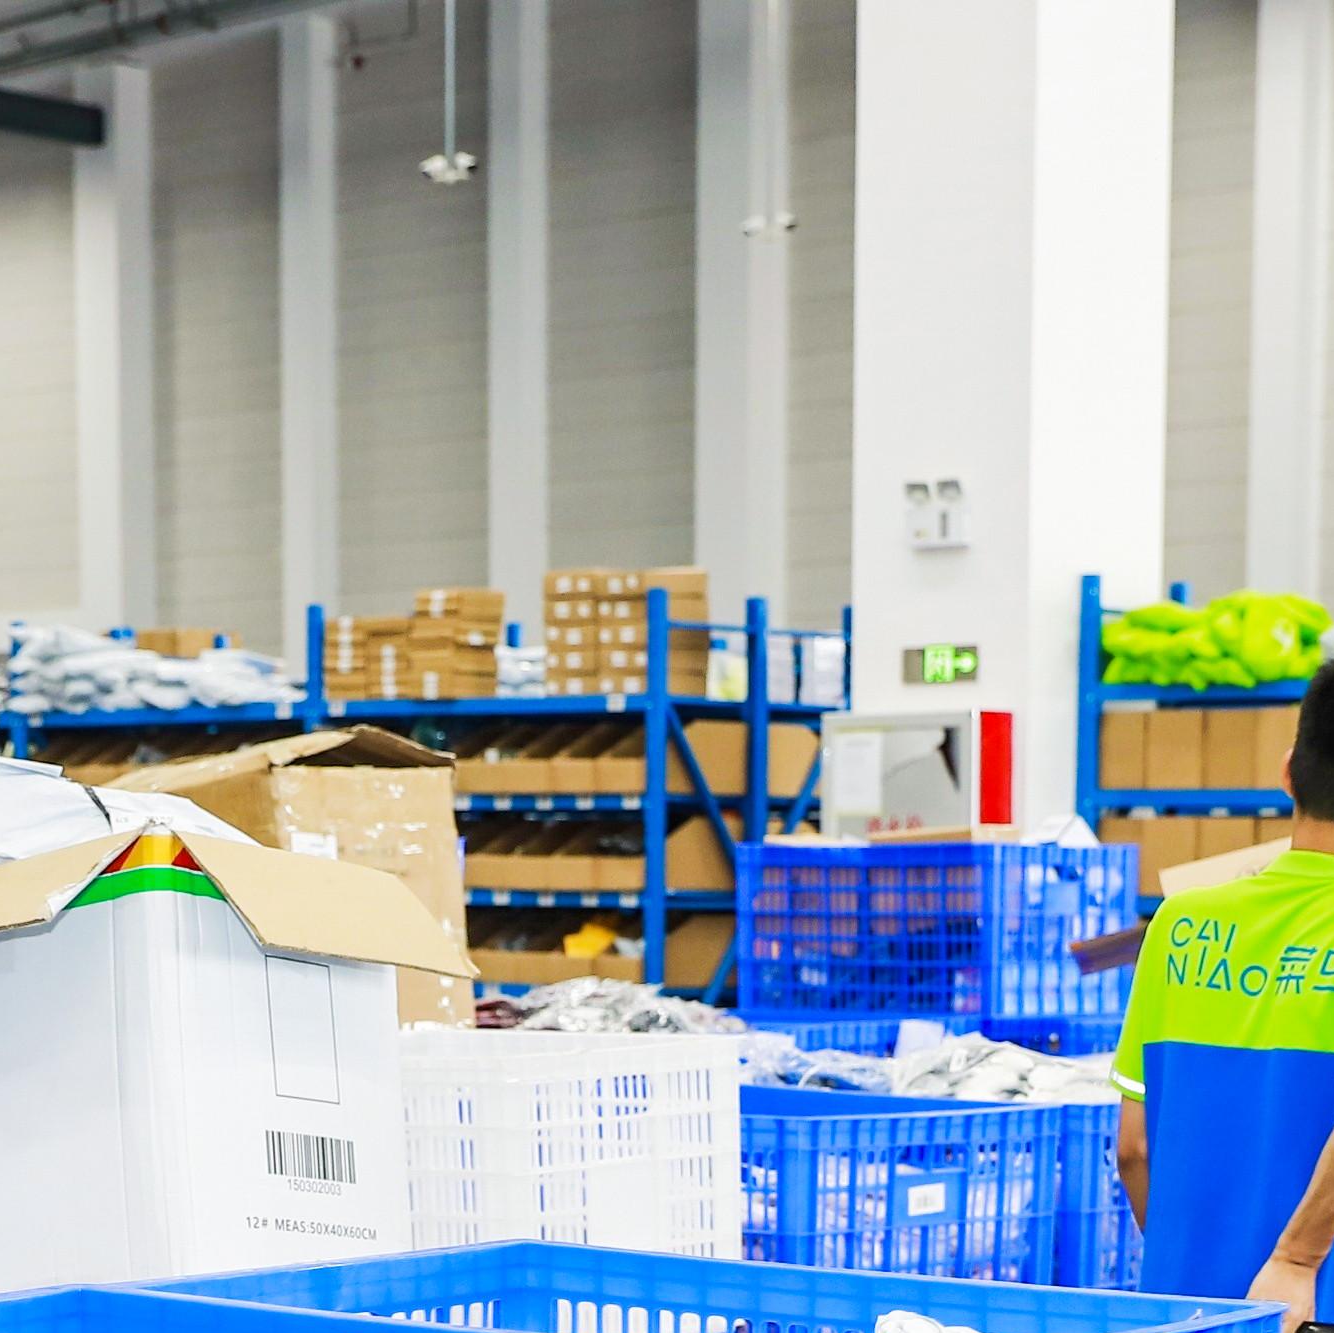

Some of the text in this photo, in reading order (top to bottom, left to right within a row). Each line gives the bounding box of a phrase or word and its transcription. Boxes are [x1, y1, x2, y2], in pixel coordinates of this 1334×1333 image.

[1171, 917, 1236, 953] CAI
[287, 1178, 342, 1196] 150302003
[246, 1216, 268, 1229] 12#
